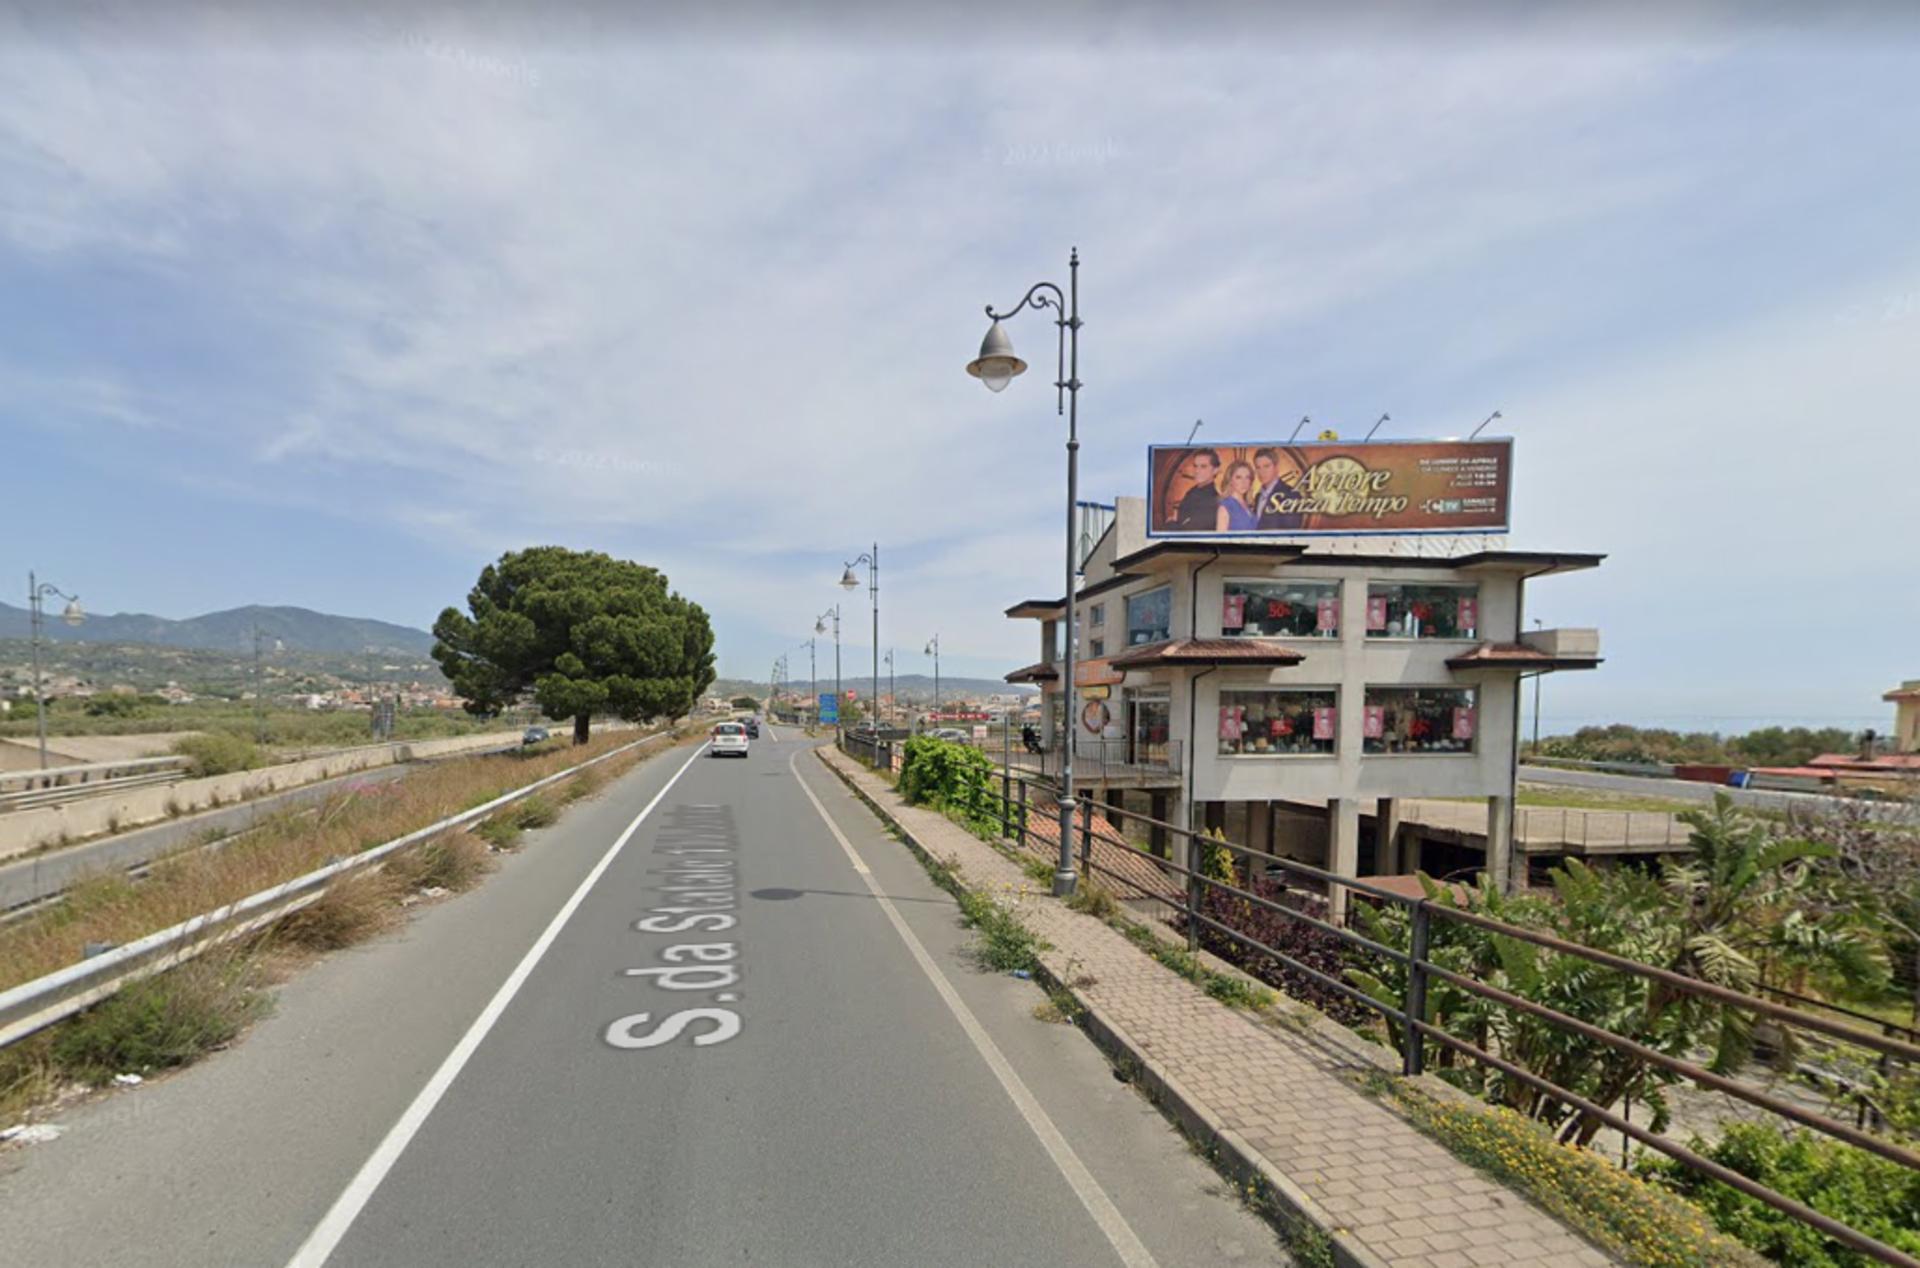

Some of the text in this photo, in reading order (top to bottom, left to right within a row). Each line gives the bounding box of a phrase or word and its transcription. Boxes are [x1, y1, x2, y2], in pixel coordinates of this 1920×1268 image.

[1292, 464, 1391, 492] Amore
[1265, 492, 1327, 514] Senza
[1335, 491, 1409, 519] Tempo
